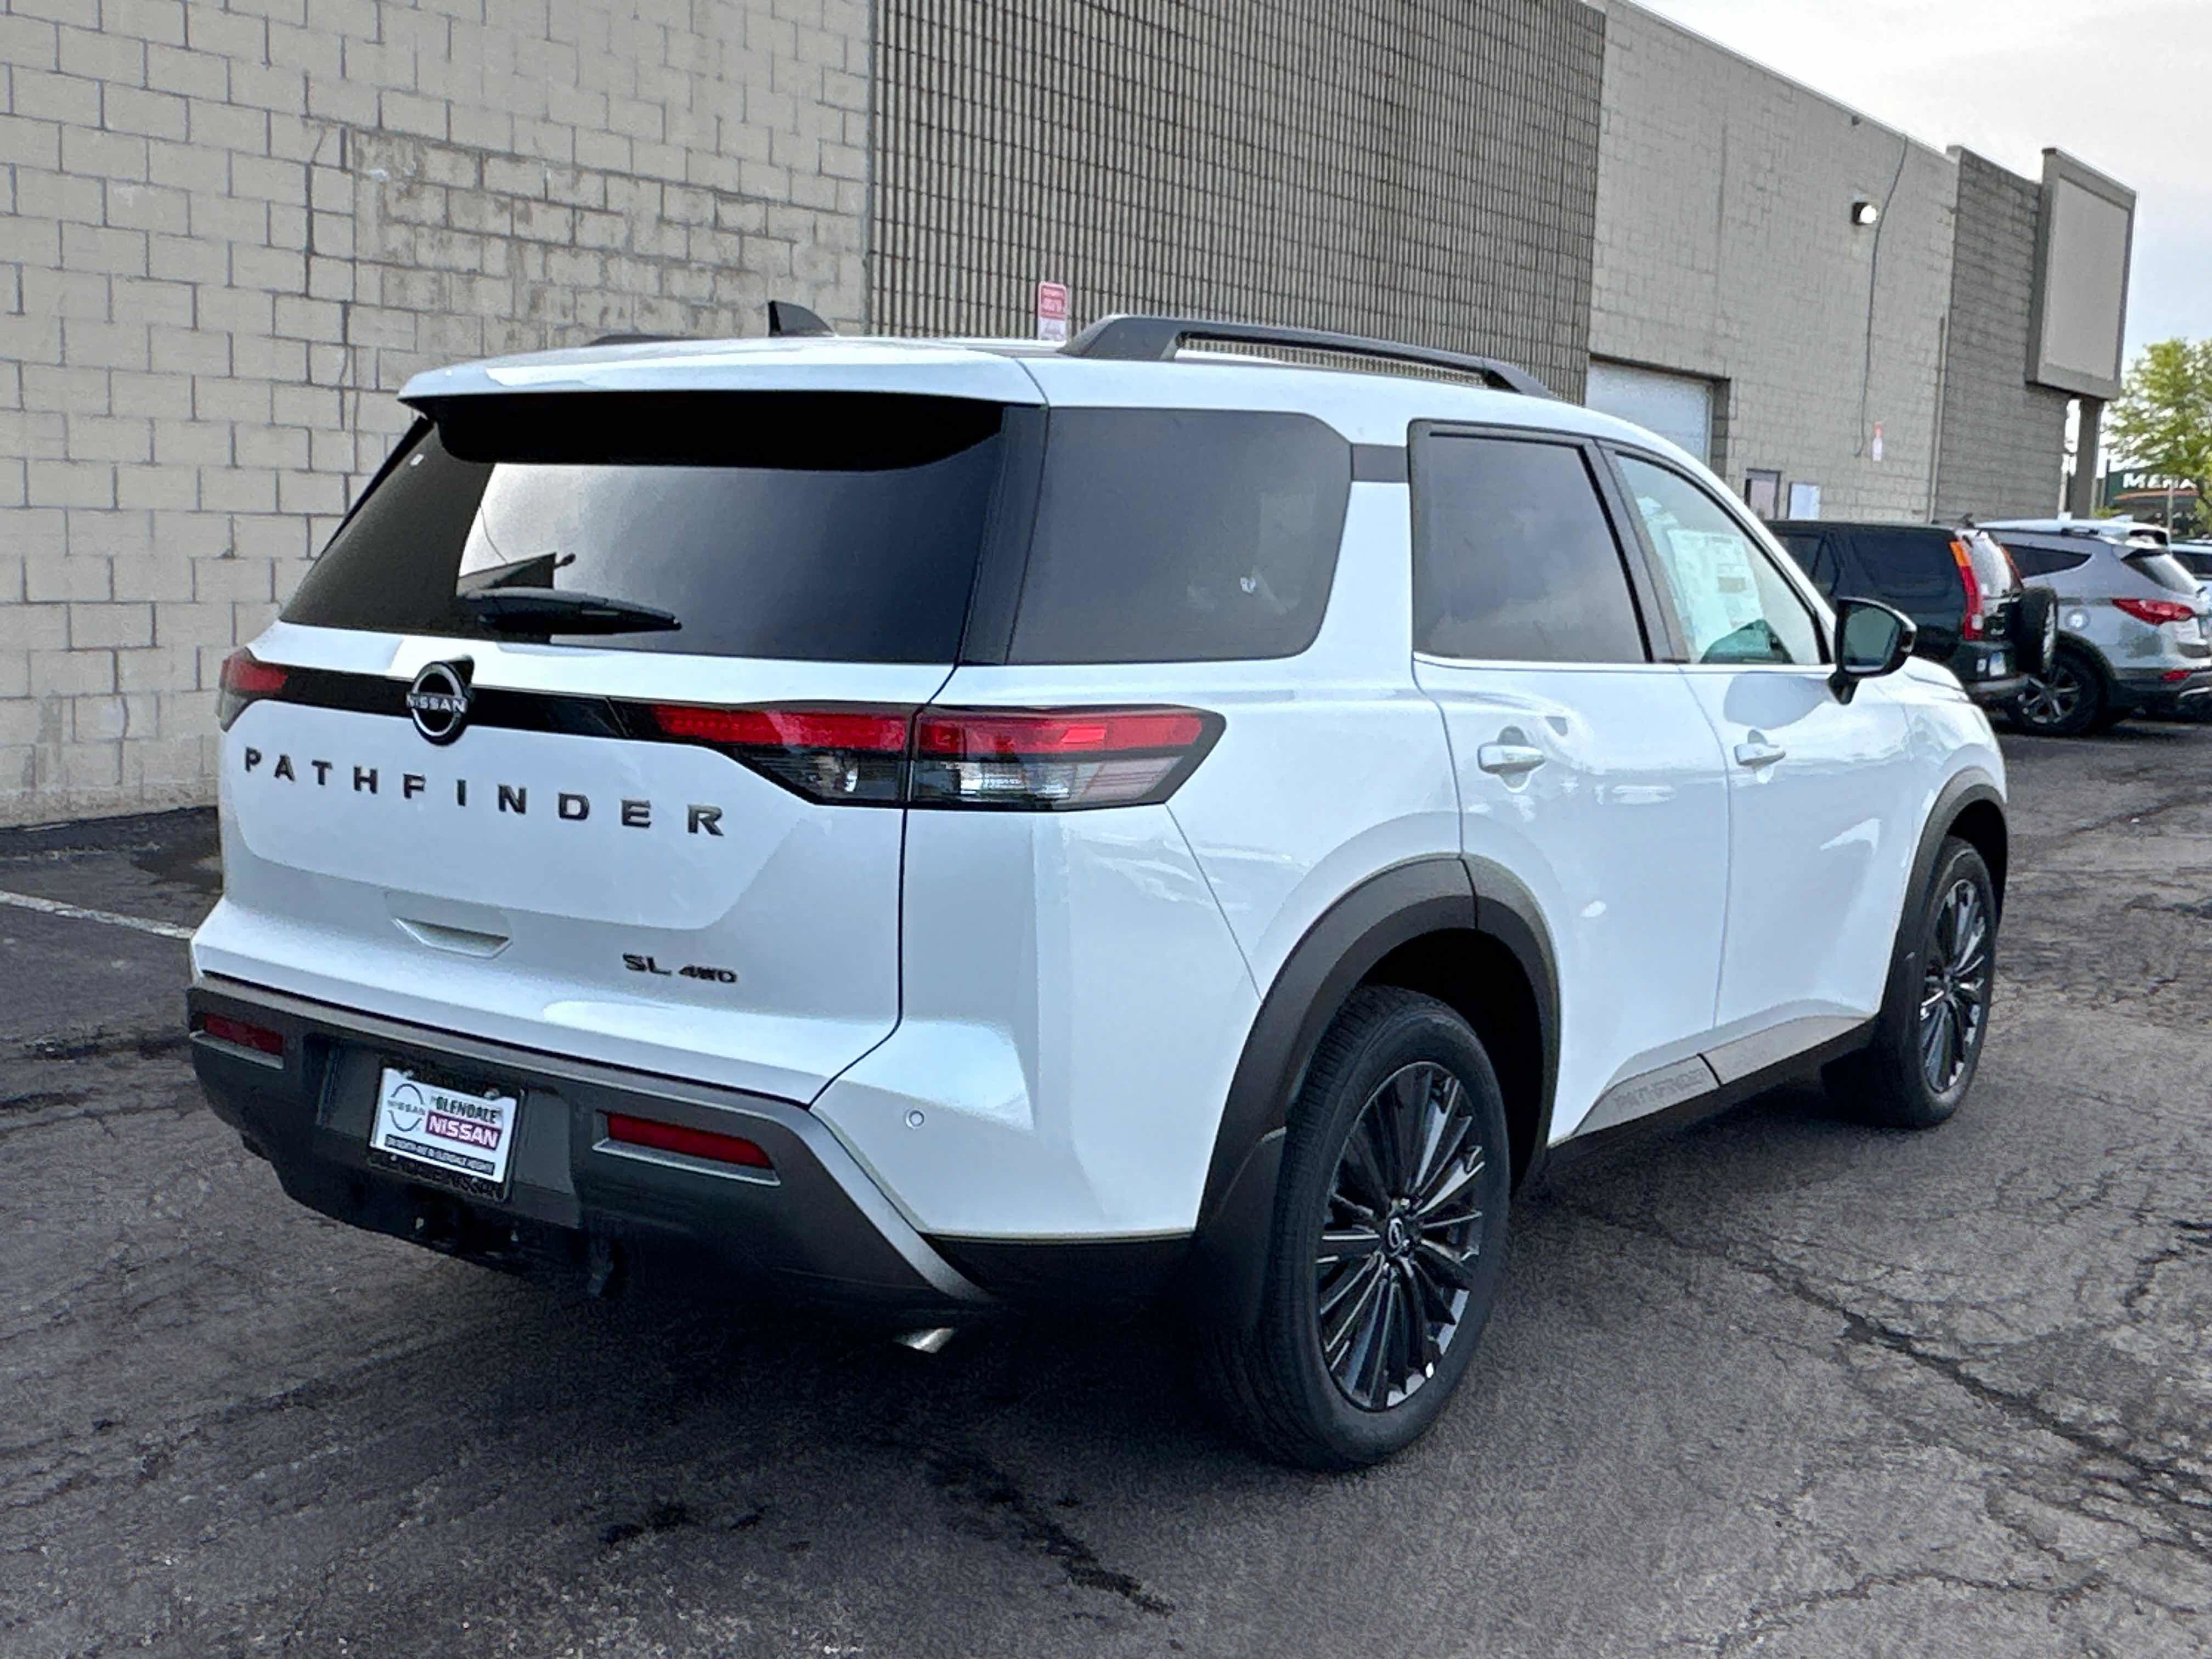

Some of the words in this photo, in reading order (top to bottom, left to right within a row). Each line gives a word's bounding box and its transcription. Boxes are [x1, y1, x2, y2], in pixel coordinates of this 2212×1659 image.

[407, 693, 466, 713] NISSAN
[245, 747, 725, 836] PATHFINDER
[622, 953, 672, 975] SL
[678, 964, 737, 983] 4WD
[387, 1099, 425, 1115] NISSAN
[436, 1096, 497, 1124] GLENDALE
[429, 1115, 498, 1148] NISSAN
